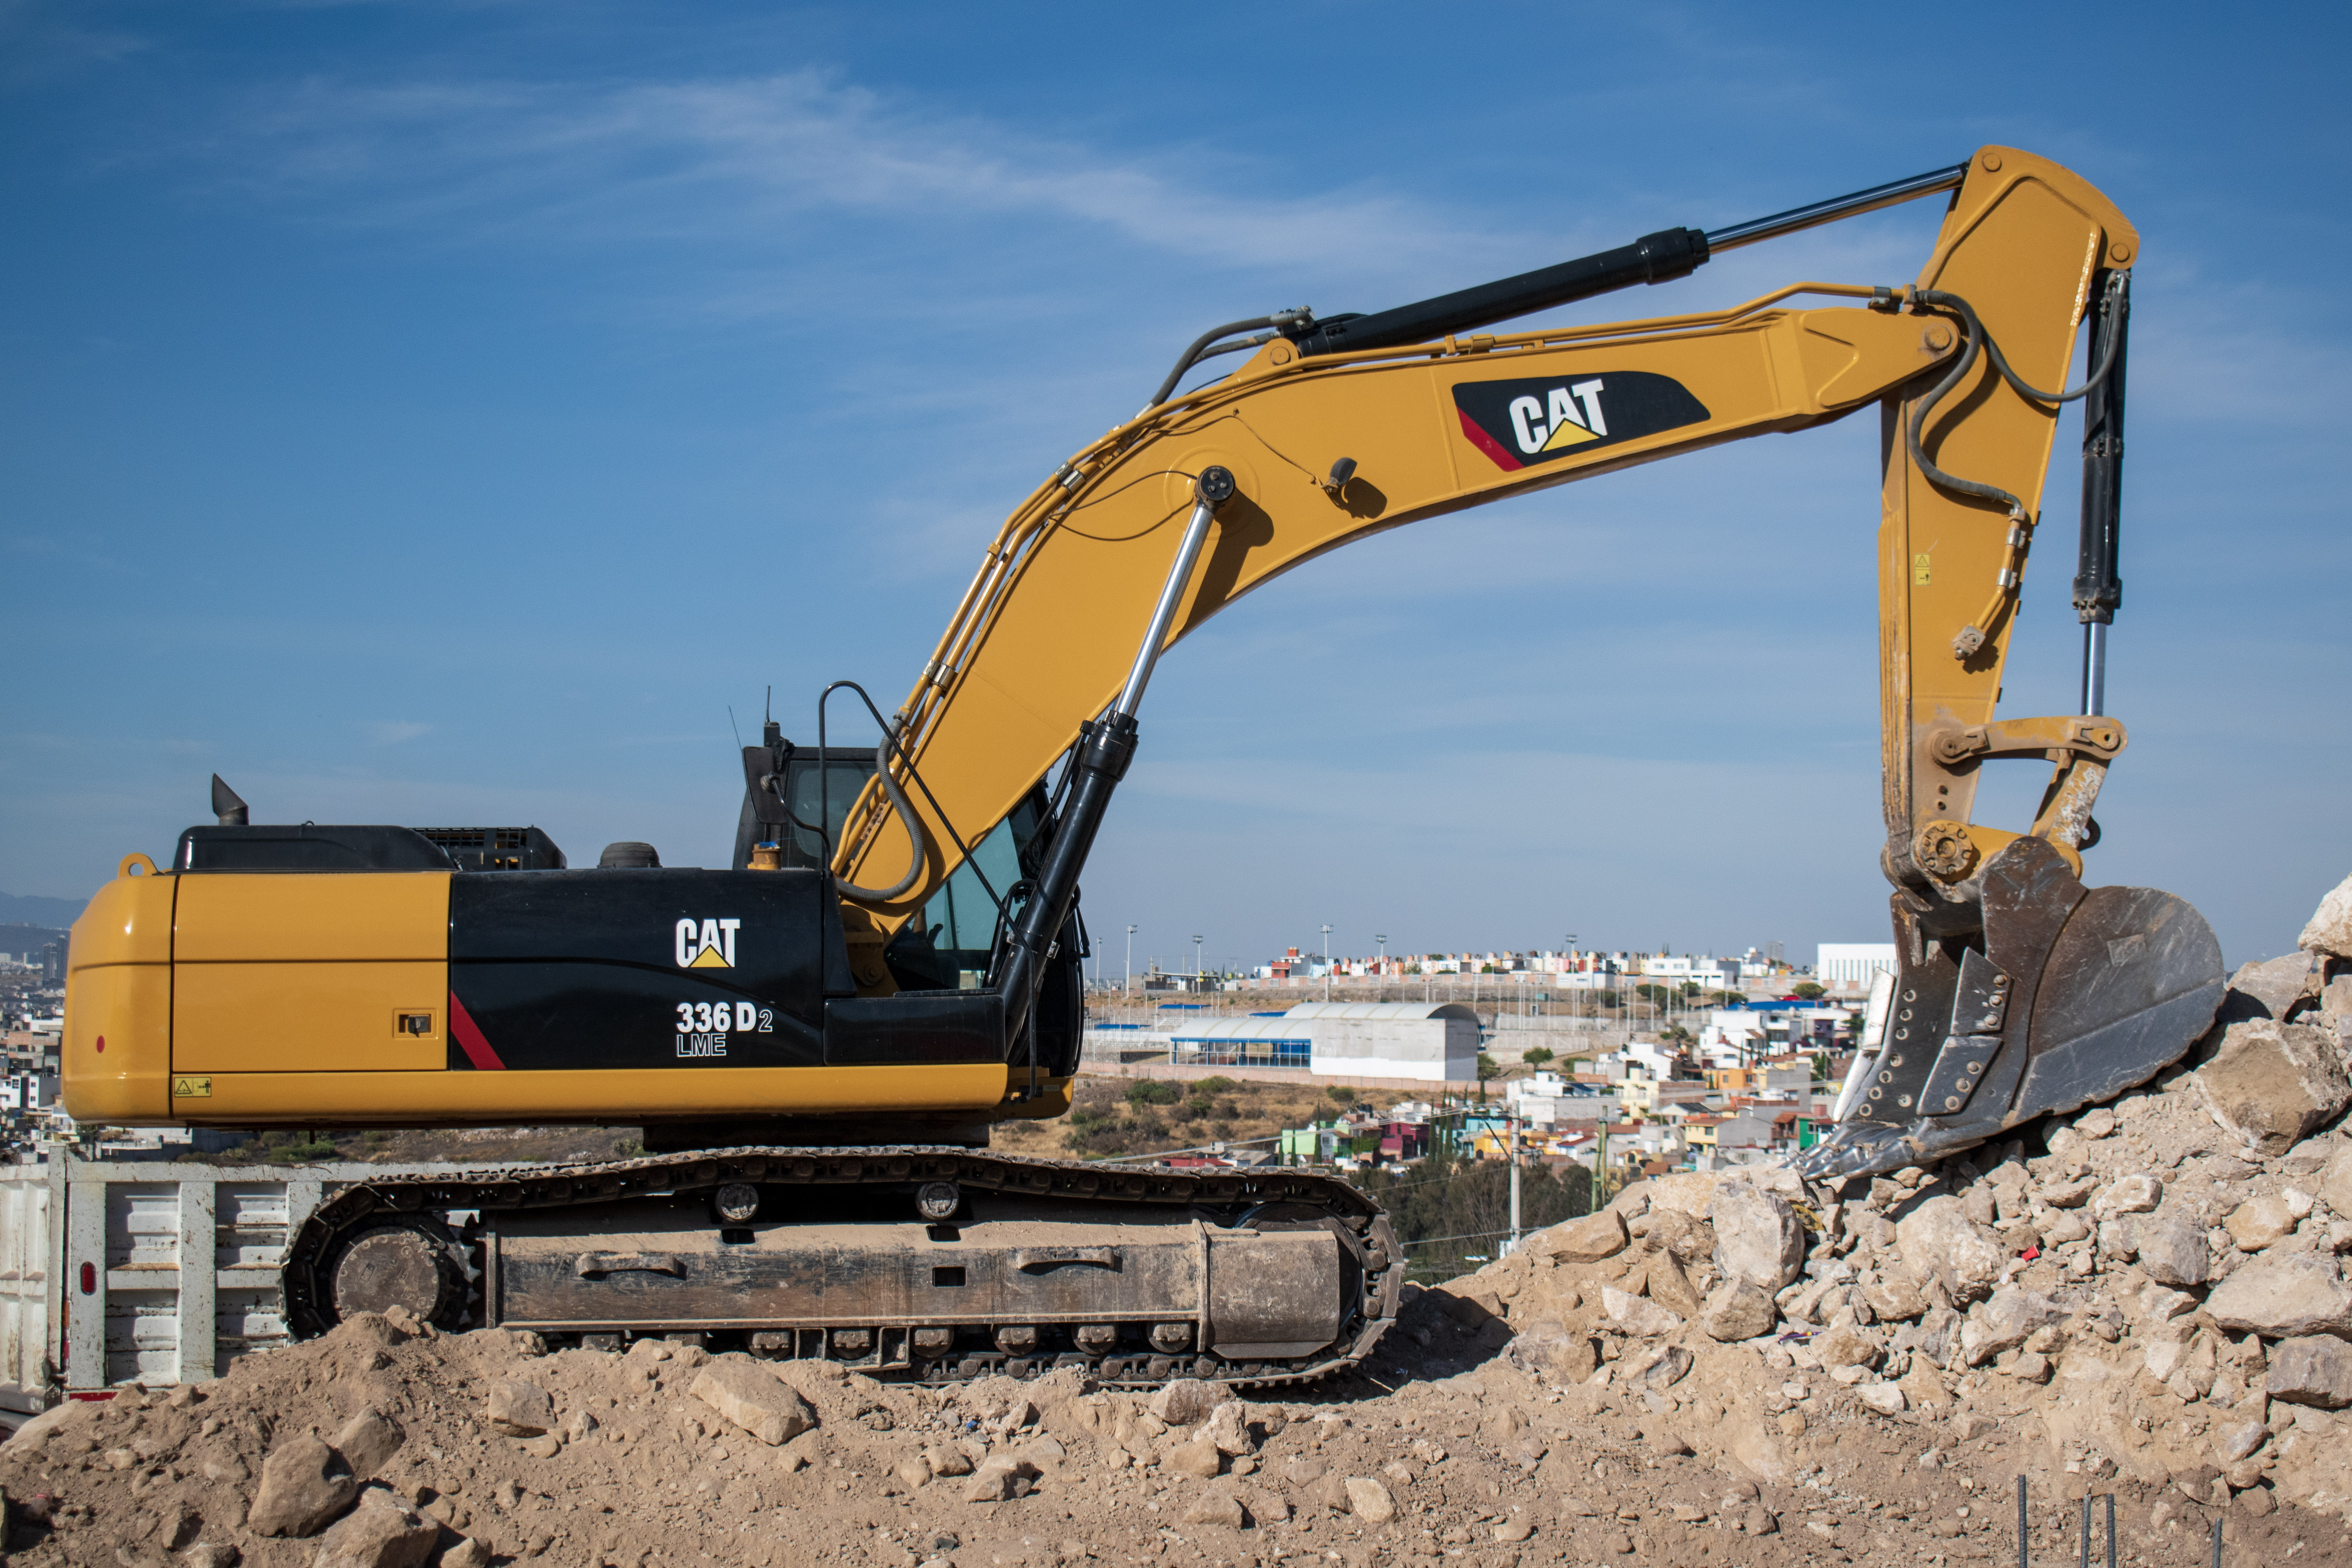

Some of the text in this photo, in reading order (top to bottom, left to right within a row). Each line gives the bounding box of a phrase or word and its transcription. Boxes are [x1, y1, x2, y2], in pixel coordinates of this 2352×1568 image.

[1509, 378, 1607, 454] CAT
[676, 918, 740, 968] CAT
[677, 1002, 731, 1033] 336
[677, 1033, 727, 1057] LME
